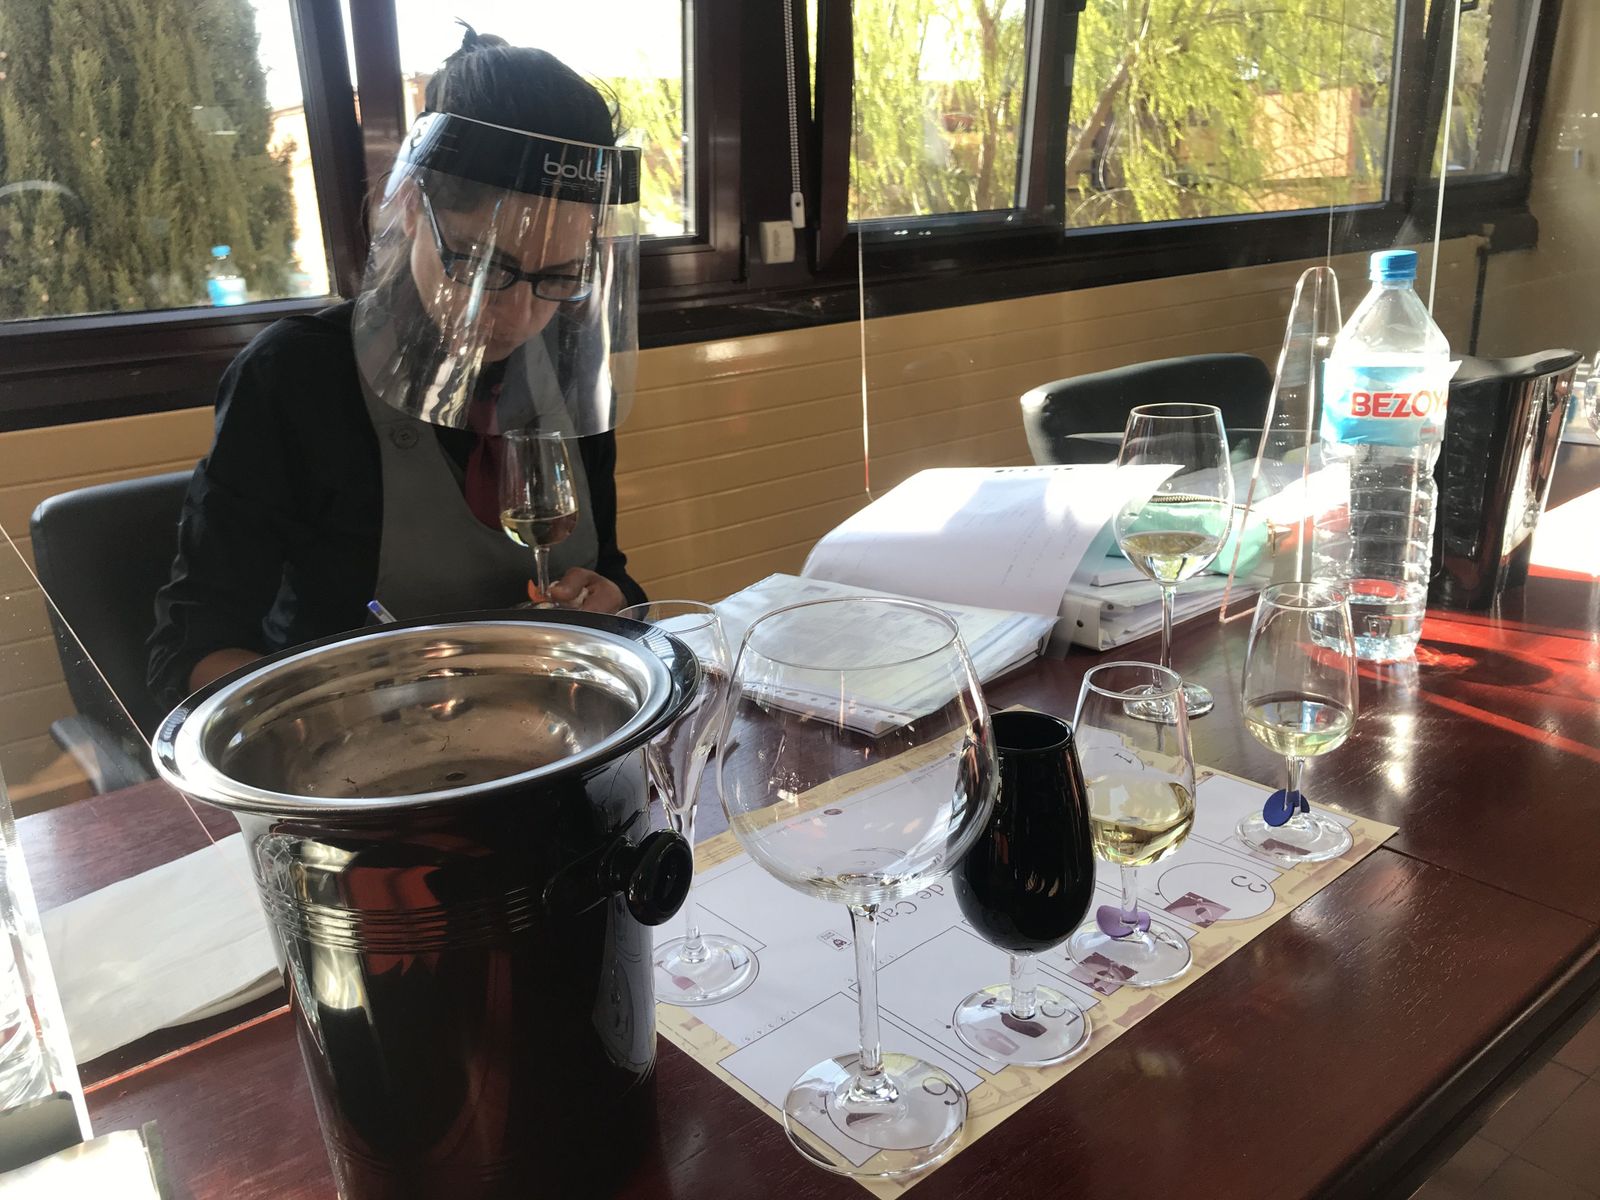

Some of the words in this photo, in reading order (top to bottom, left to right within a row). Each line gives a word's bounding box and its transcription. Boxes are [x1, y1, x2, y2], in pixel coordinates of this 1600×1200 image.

[915, 884, 944, 899] de
[1231, 875, 1267, 893] 3
[876, 900, 918, 926] Cat
[1040, 999, 1080, 1026] 5
